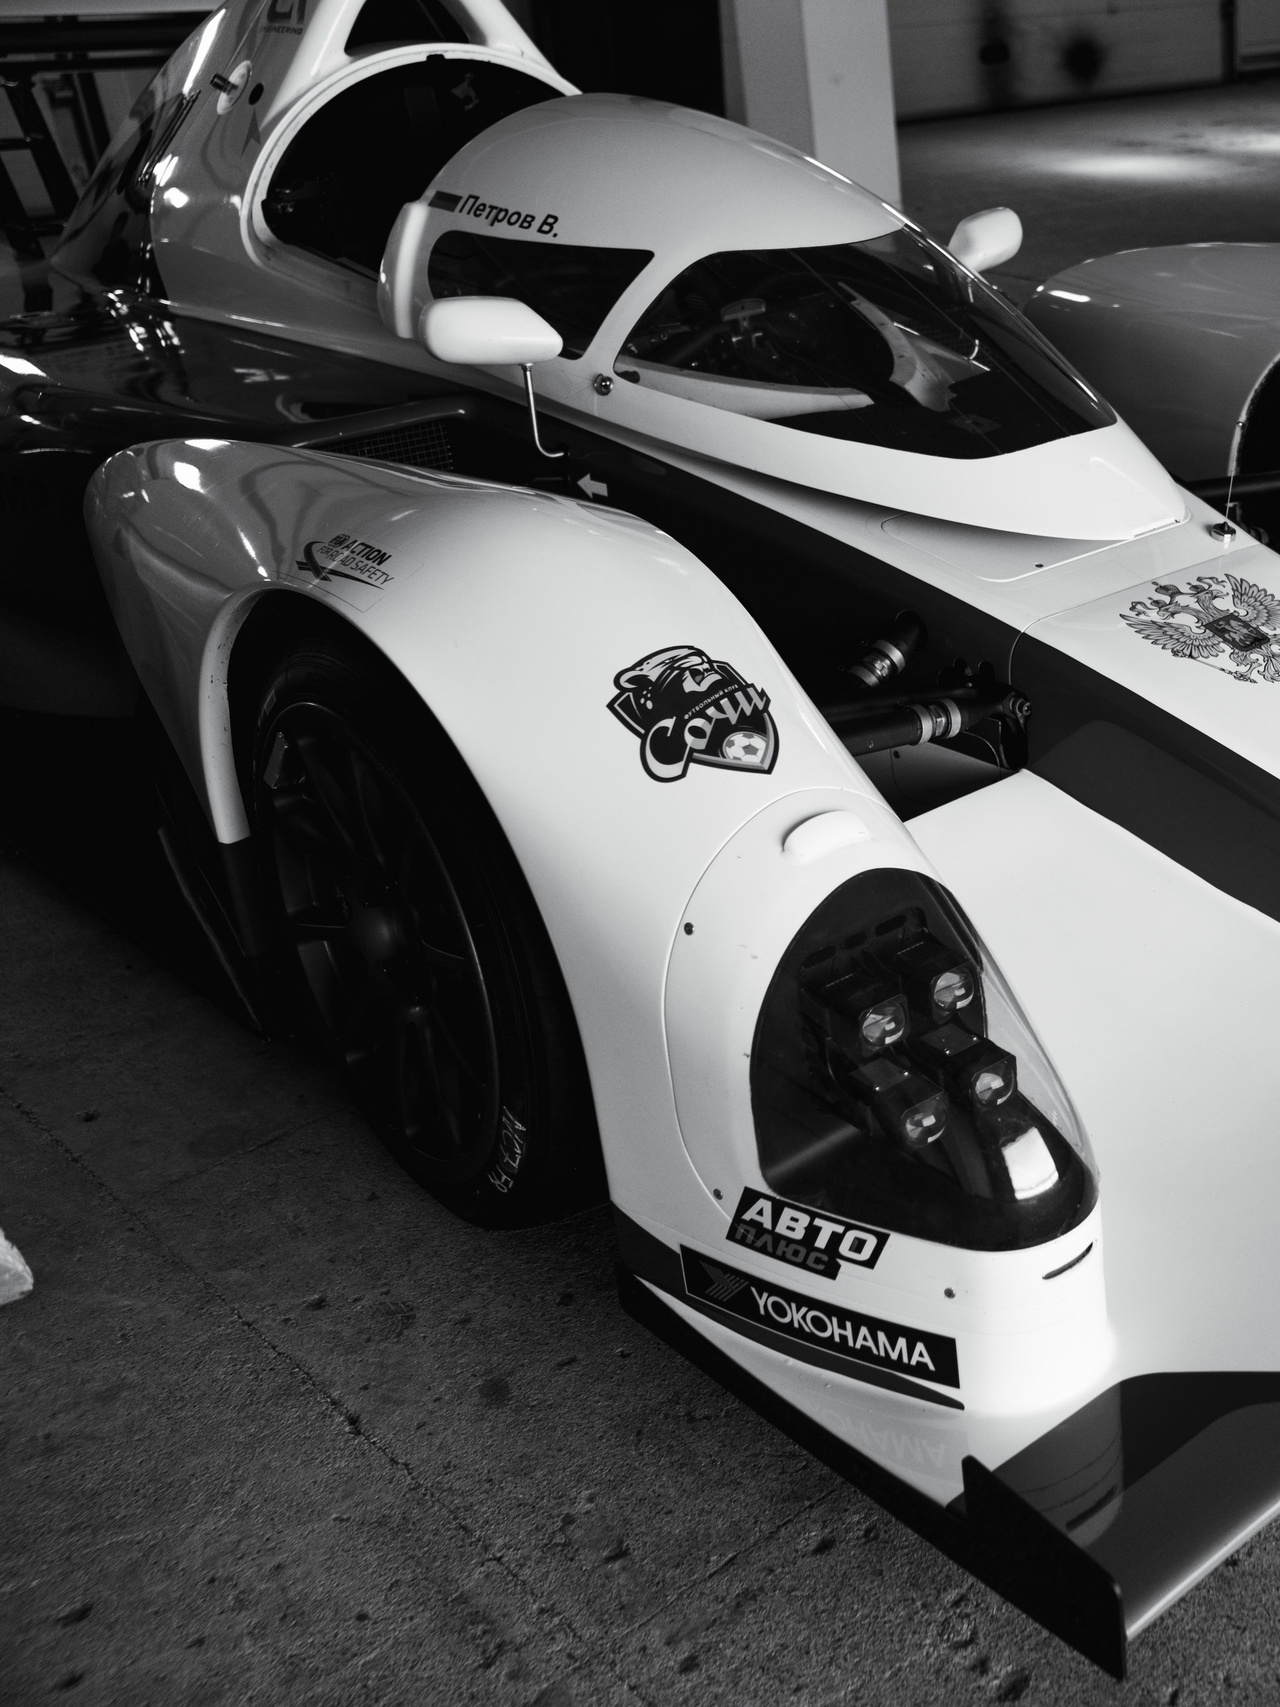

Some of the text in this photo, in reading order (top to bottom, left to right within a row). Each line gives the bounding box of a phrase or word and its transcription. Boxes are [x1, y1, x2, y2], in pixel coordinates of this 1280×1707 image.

[459, 194, 560, 238] Петров В.
[317, 546, 394, 585] FOR ROAD SAFETY
[341, 540, 392, 566] ACTION
[684, 684, 739, 720] ФУТБОЛЬНЫЙ КЛУБ
[735, 1222, 829, 1271] ПЛЮС
[741, 1197, 878, 1262] АВТО
[750, 1287, 936, 1371] YOKOHAMA
